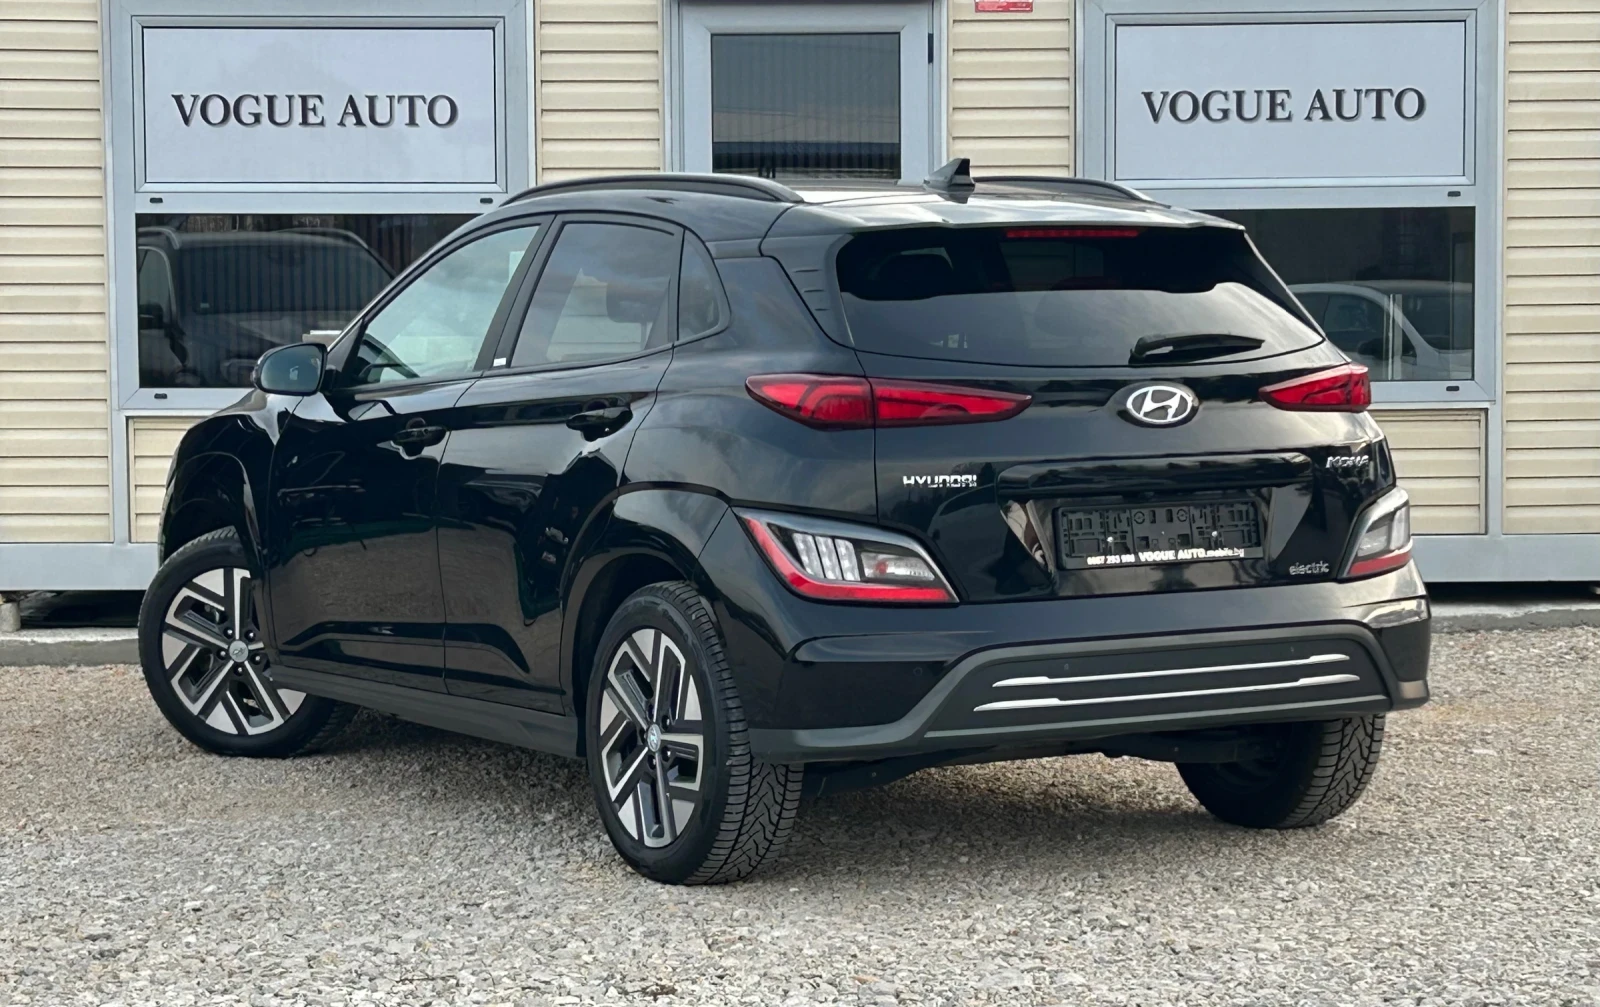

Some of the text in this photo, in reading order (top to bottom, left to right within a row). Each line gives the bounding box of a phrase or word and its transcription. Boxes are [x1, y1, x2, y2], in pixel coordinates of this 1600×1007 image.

[171, 93, 459, 128] VOGUE AUTO
[1141, 87, 1427, 124] VOGUE AUTO
[902, 474, 977, 488] HYUNDAI
[1138, 550, 1176, 562] VOGUE
[1289, 560, 1330, 575] electric
